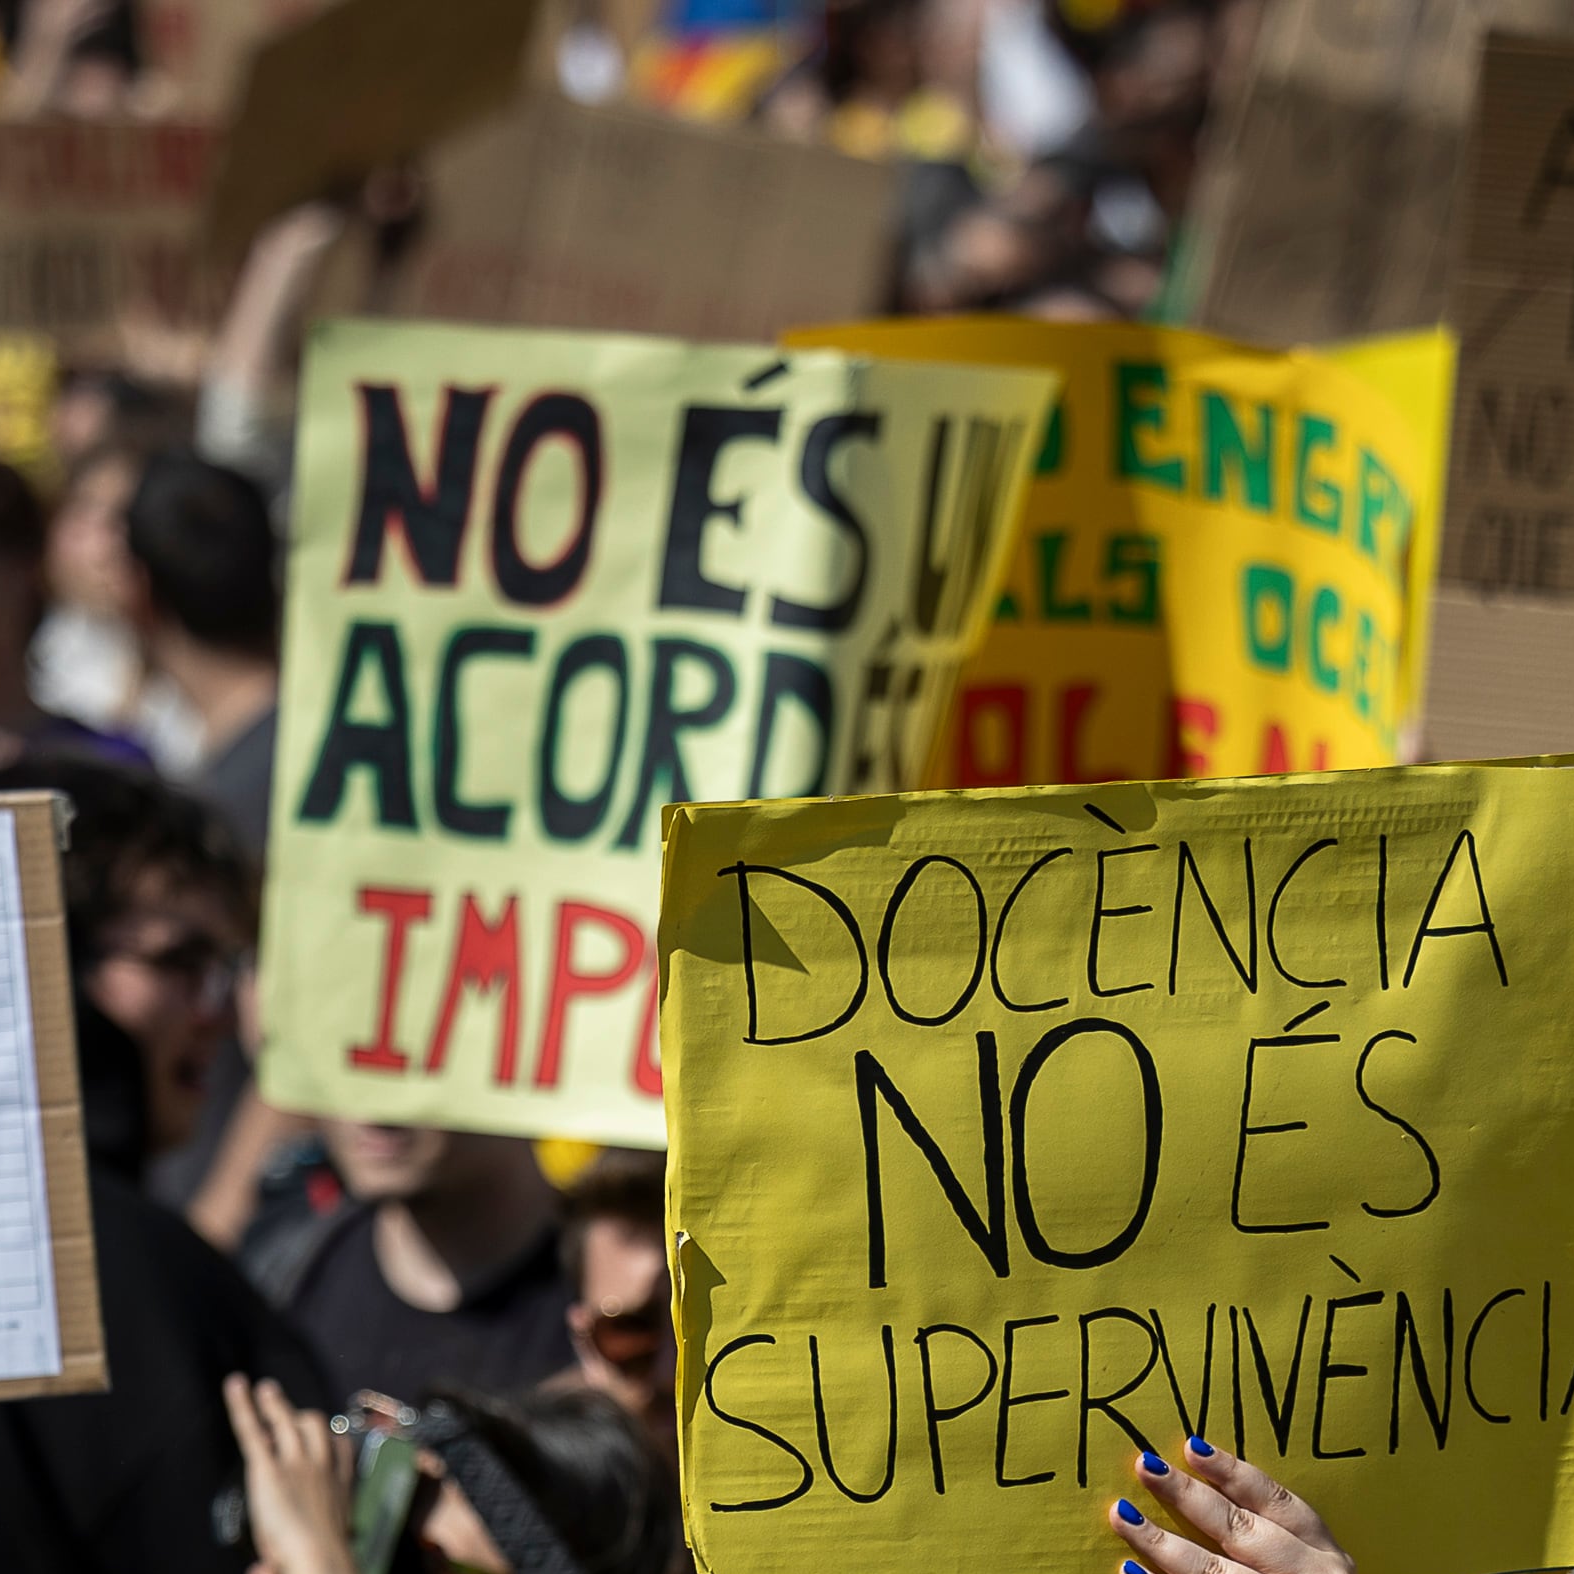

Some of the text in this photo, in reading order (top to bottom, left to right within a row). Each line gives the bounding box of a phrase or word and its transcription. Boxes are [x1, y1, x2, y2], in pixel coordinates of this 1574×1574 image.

[342, 381, 604, 607] NO
[655, 360, 881, 632] ÉS
[298, 622, 838, 851] ACORD
[716, 803, 1509, 1046] DOCÈNCIA
[855, 1001, 1442, 1288] NO ÉS
